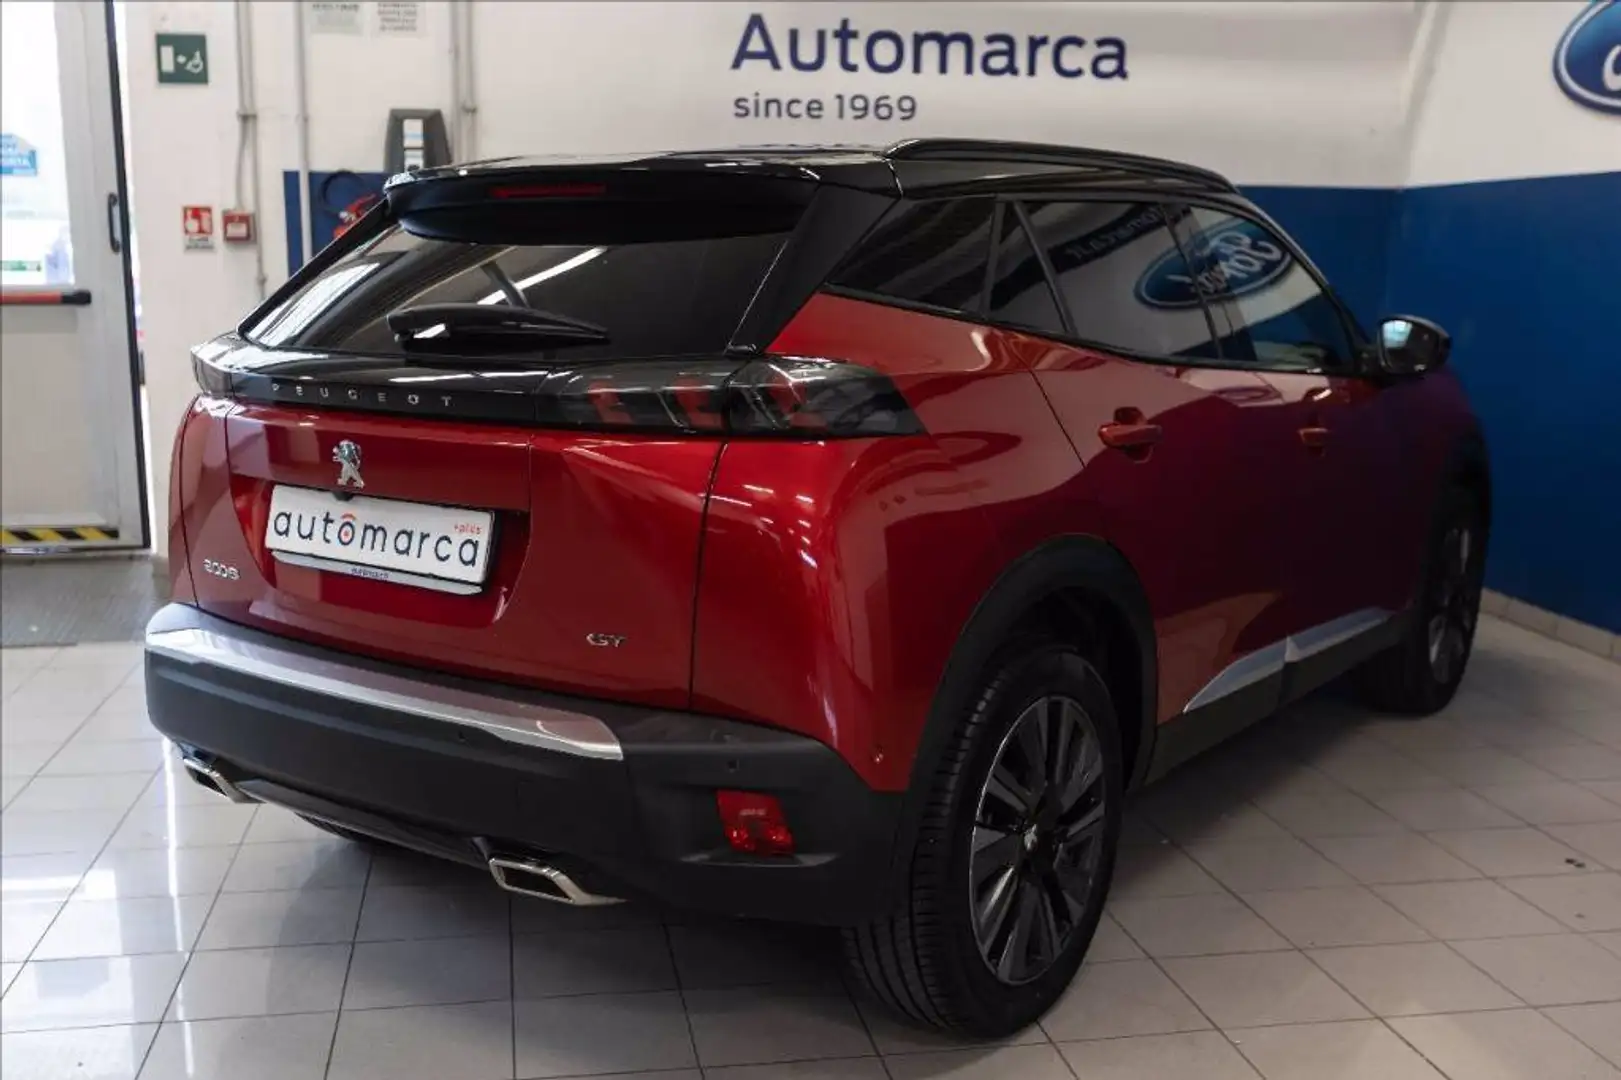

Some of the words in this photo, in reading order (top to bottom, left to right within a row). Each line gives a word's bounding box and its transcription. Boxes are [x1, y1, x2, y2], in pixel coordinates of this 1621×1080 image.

[730, 13, 1129, 81] Automarca
[733, 92, 825, 120] since
[835, 93, 918, 121] 1969
[272, 382, 452, 407] PEUGEOT
